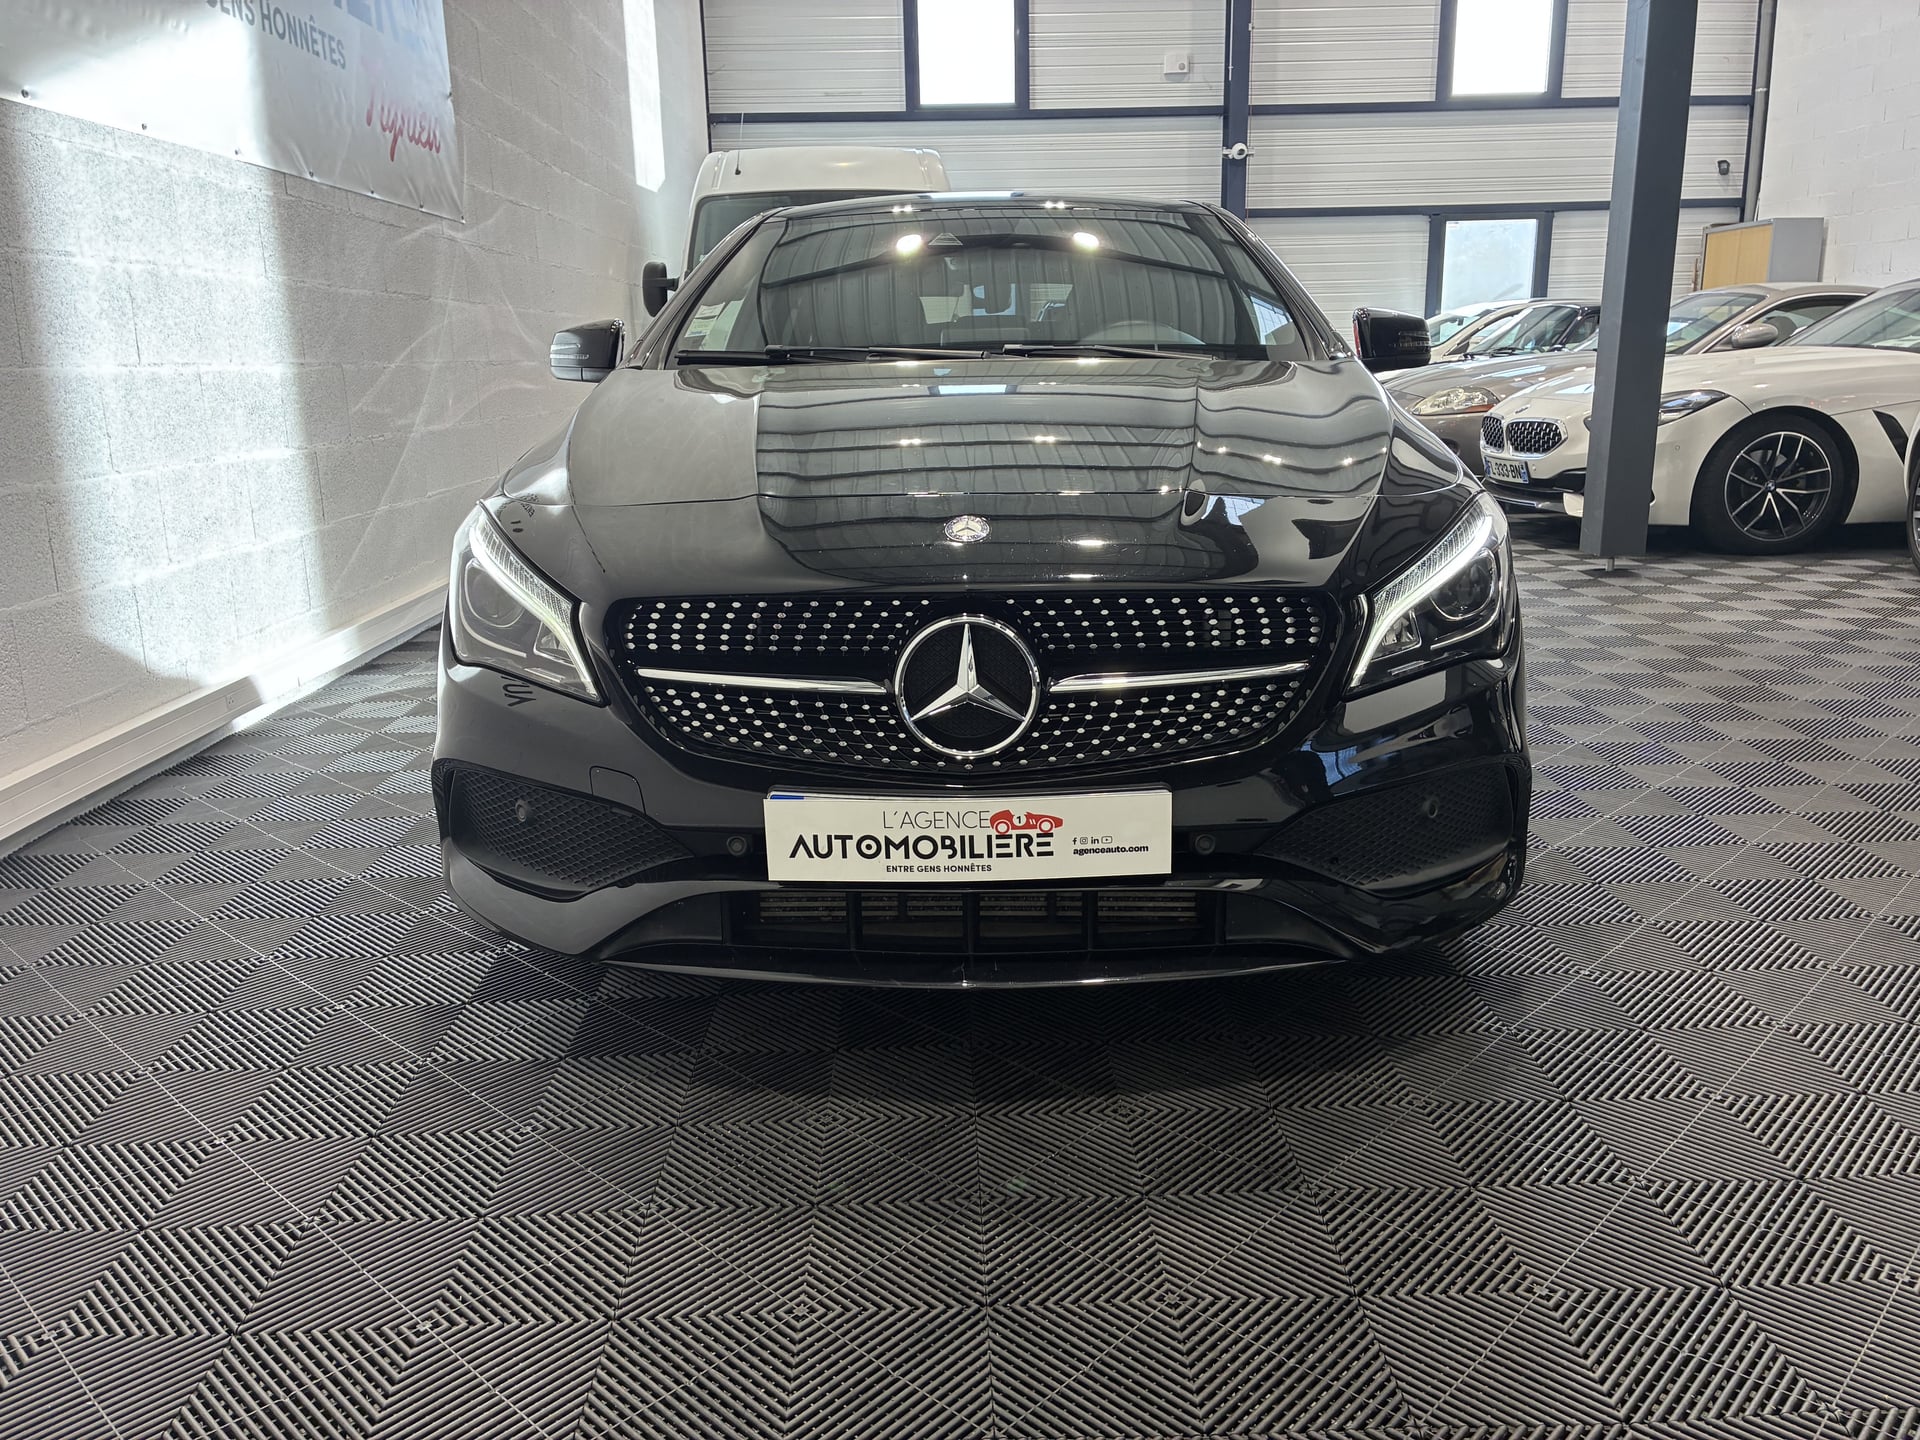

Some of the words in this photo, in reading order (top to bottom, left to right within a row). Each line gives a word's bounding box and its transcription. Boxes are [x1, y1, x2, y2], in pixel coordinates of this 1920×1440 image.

[259, 1, 346, 70] HONNÊTES
[882, 810, 991, 830] L'AGENCE
[1073, 845, 1149, 856] agenceauto.com
[886, 864, 915, 873] ENTRE
[917, 864, 942, 873] GENS
[943, 862, 992, 872] HONNÊTES
